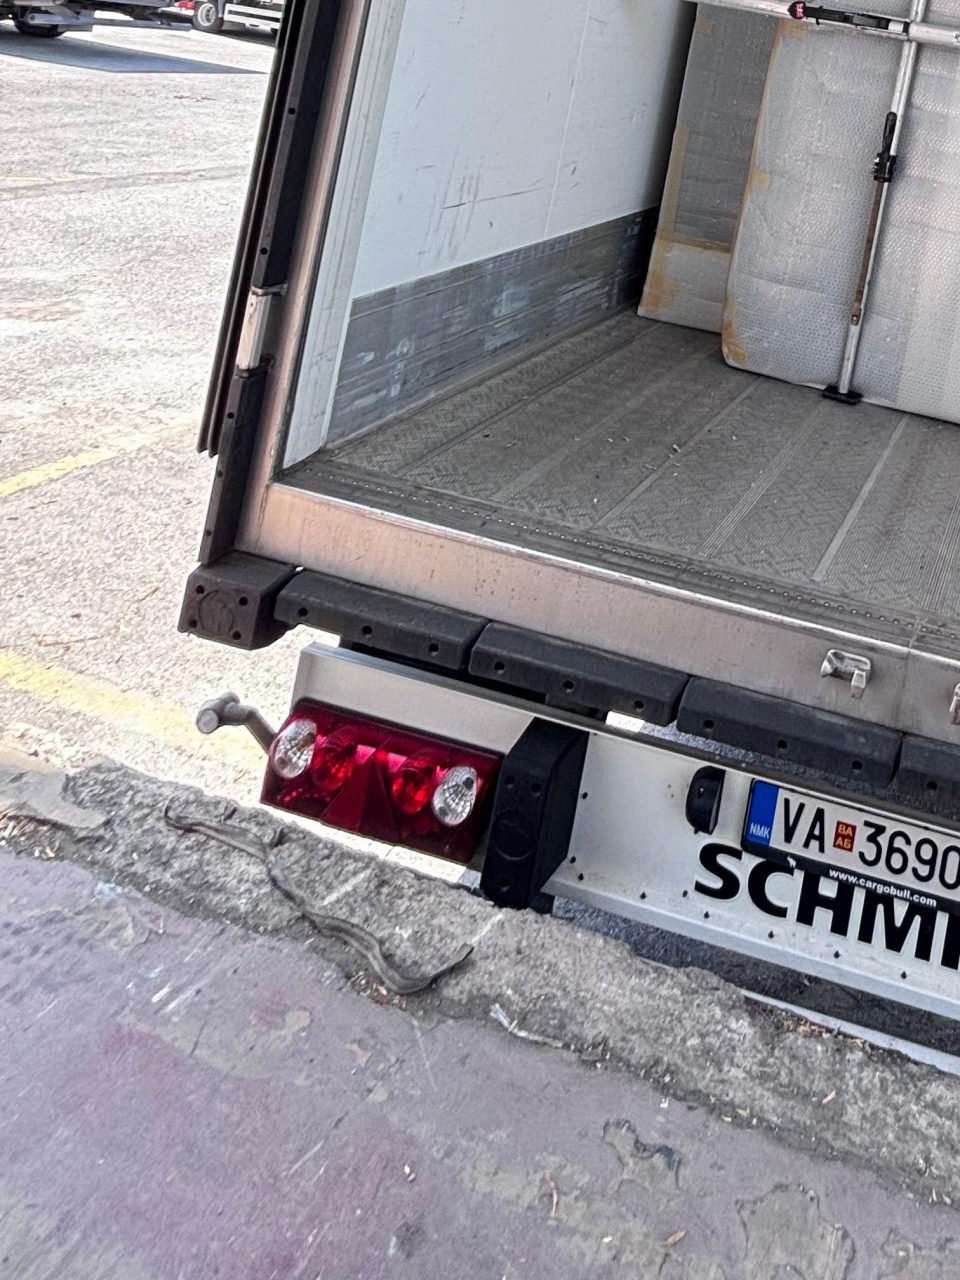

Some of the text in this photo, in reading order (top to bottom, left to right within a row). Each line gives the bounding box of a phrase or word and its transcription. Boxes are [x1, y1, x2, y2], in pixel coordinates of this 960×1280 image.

[749, 822, 771, 839] NMK
[783, 797, 825, 853] VA
[829, 869, 937, 907] www.cargobull.com
